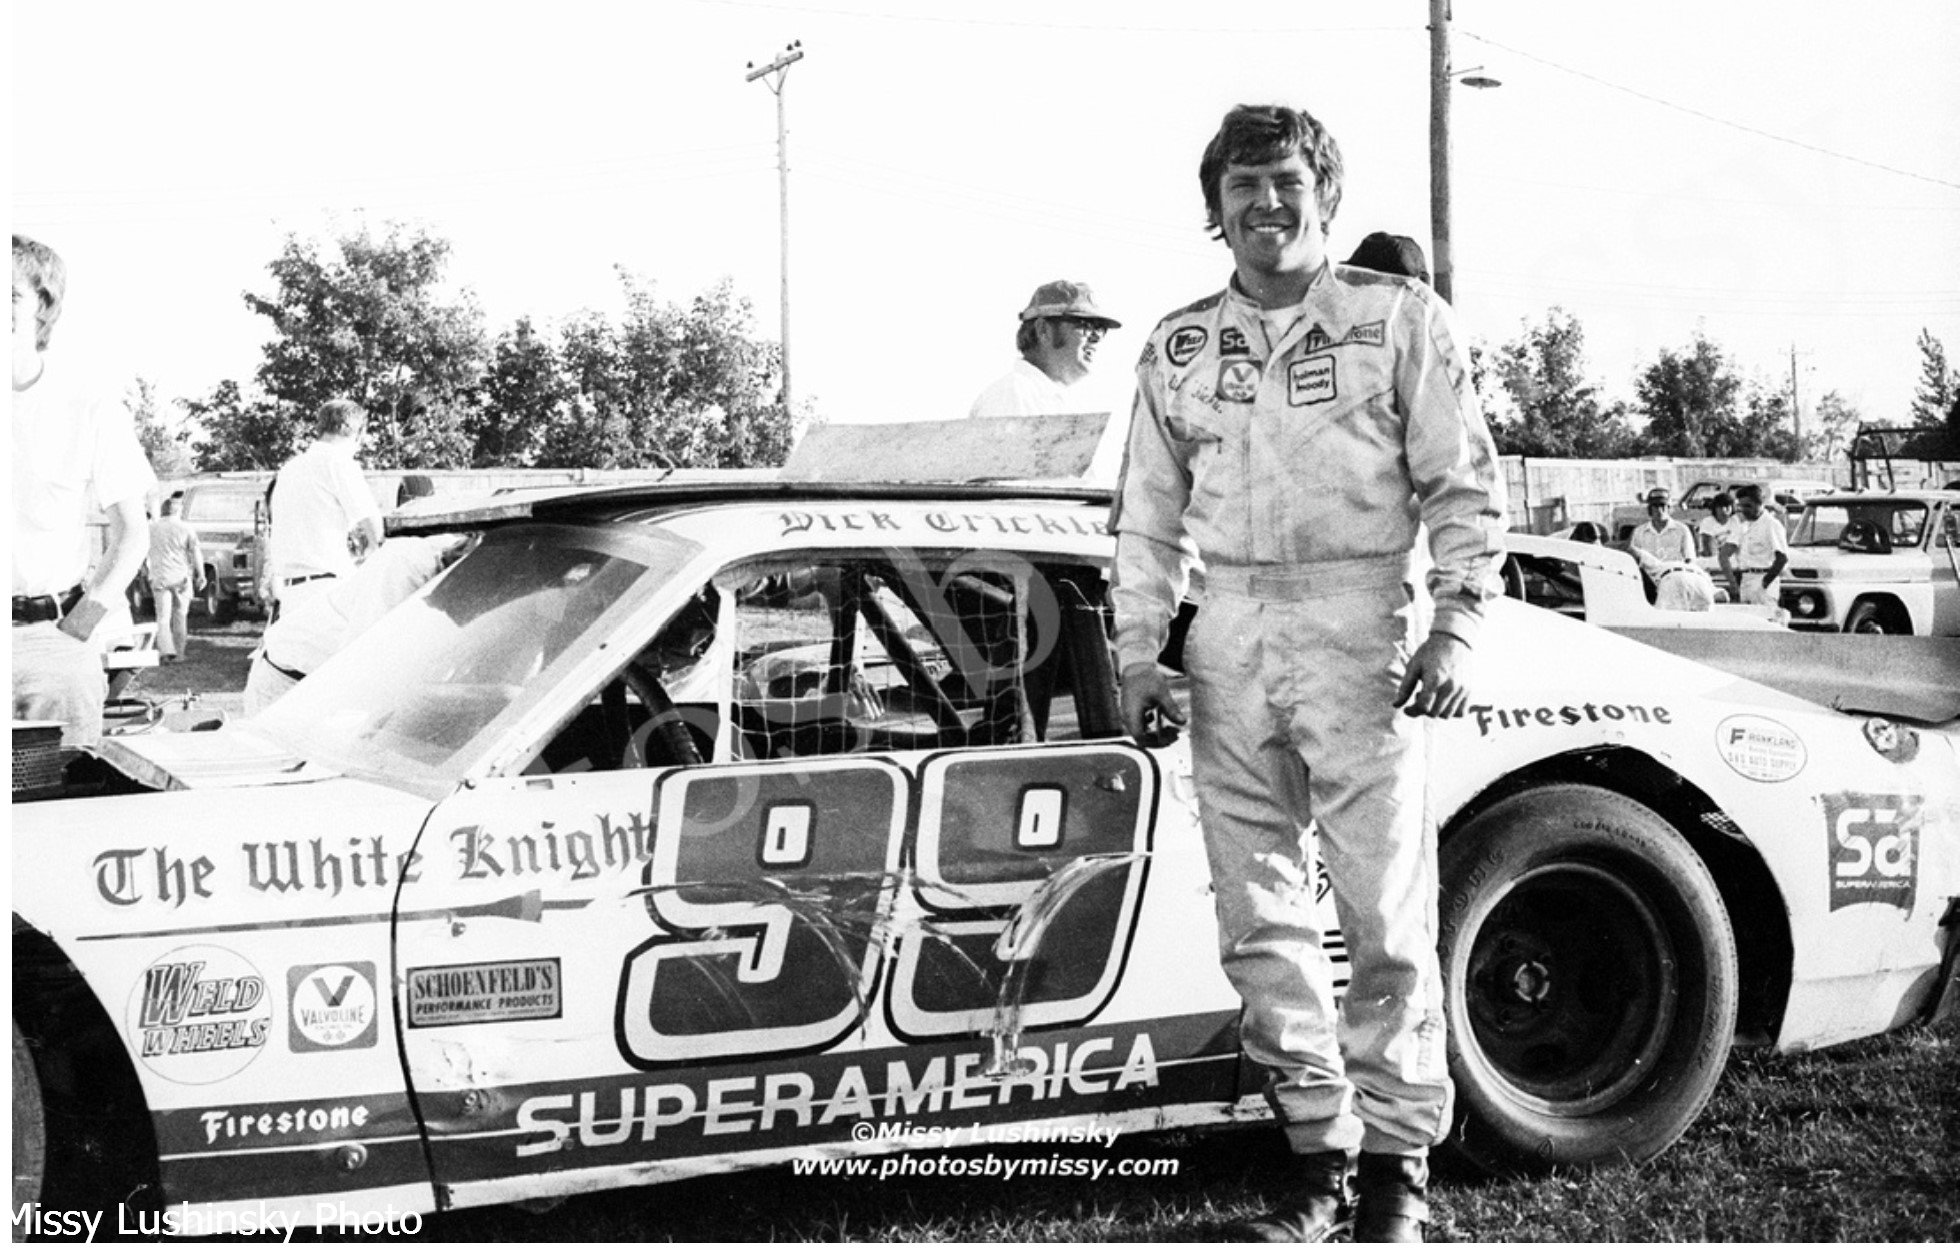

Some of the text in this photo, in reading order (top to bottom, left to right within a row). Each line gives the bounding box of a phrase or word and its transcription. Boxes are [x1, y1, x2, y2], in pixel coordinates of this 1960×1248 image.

[779, 509, 902, 537] Dick
[1469, 703, 1673, 737] Firestone
[93, 812, 655, 910] The White Knight
[615, 741, 1161, 1071] 99
[139, 961, 265, 1029] WELD
[414, 965, 553, 999] SCHOENFELD'S
[301, 1005, 366, 1027] VALVOLINE
[415, 999, 492, 1015] PERFORMANCE
[498, 995, 553, 1009] PRODUCTS
[142, 1018, 271, 1058] WHEELS
[515, 1032, 1160, 1158] SUPERAMERICA
[199, 1104, 369, 1145] Firestone
